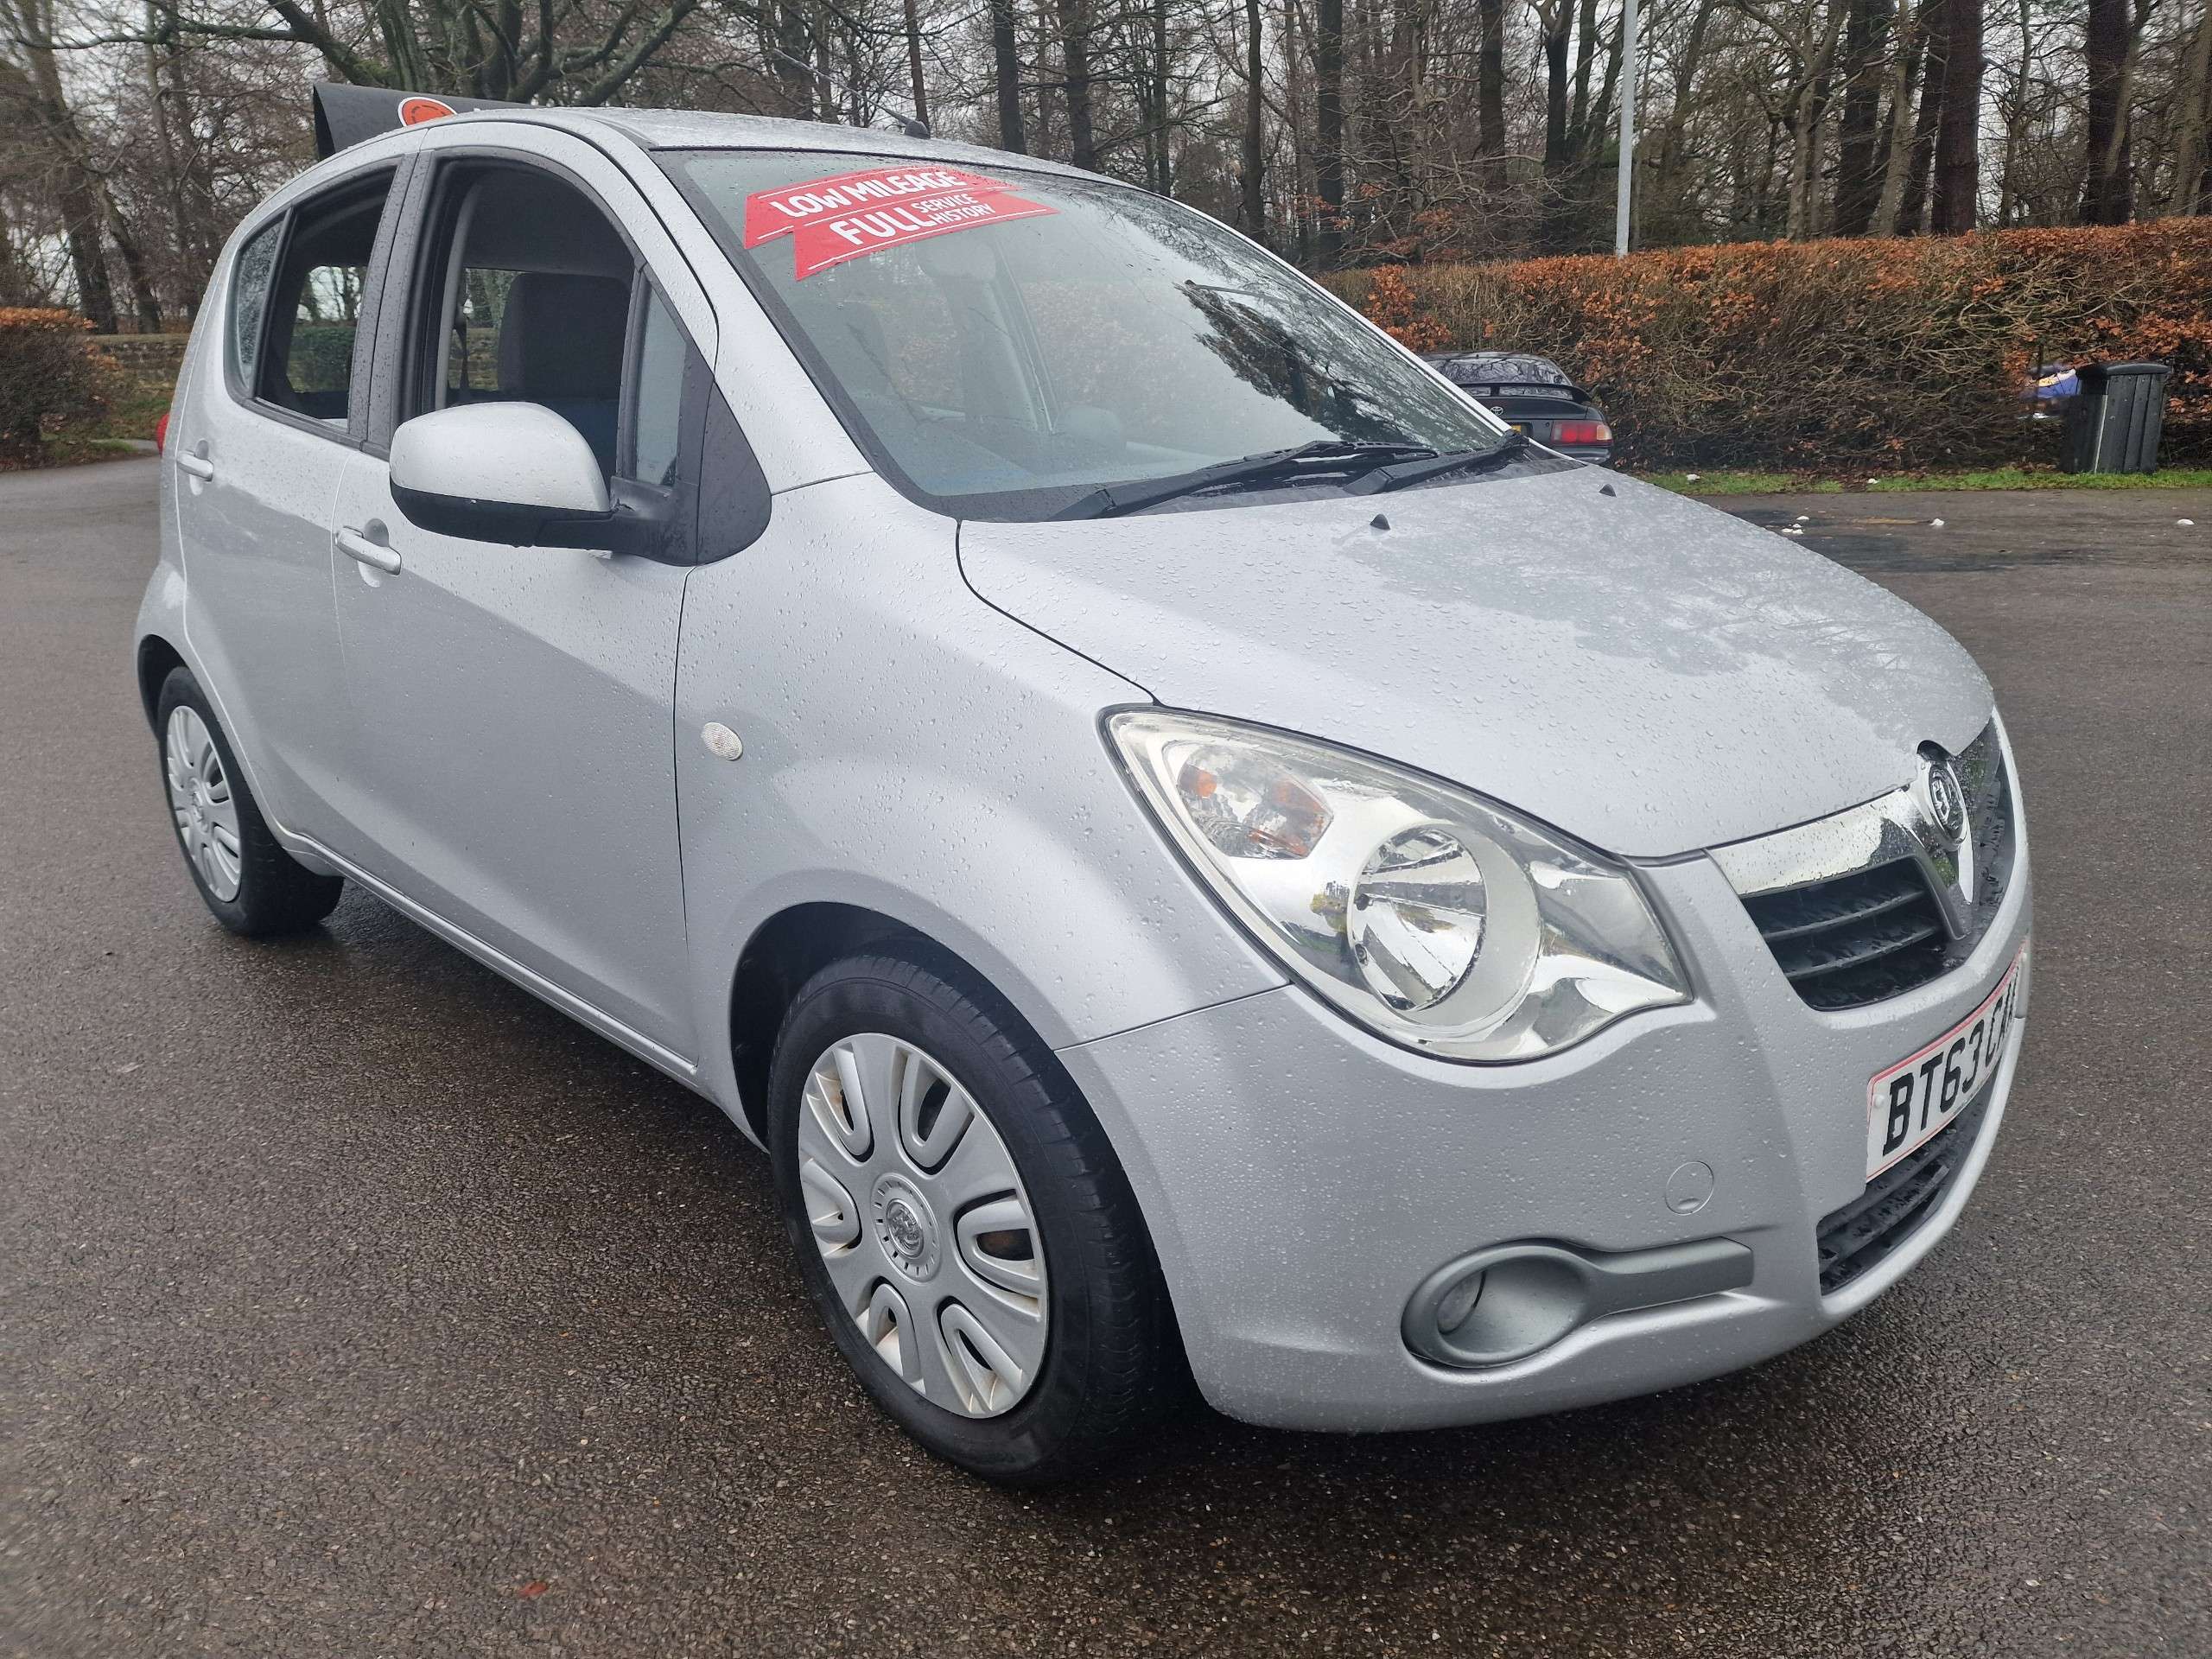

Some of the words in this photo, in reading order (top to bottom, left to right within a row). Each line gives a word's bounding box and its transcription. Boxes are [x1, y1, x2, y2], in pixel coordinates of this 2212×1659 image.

[770, 188, 852, 217] LOW
[838, 171, 967, 201] MILEAGE
[911, 193, 979, 213] SERVICE
[830, 207, 938, 245] FULL
[927, 203, 996, 225] HISTORY
[1882, 1019, 1986, 1158] BT63
